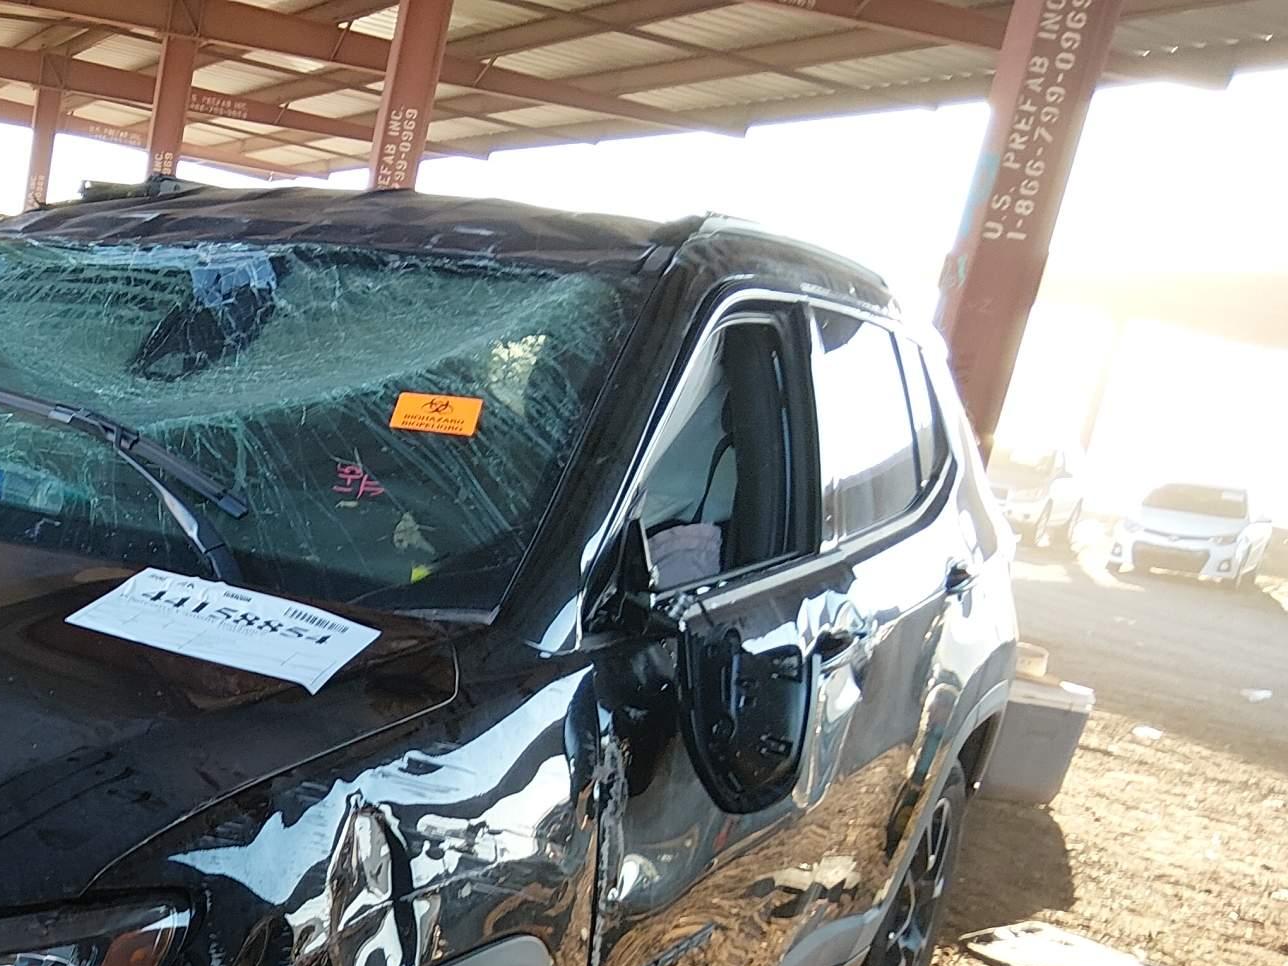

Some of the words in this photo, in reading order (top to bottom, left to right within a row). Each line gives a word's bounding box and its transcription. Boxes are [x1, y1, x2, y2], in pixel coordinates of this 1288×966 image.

[982, 187, 1016, 240] U.S.
[1003, 56, 1049, 170] PREFAB
[142, 590, 333, 645] 44158854
